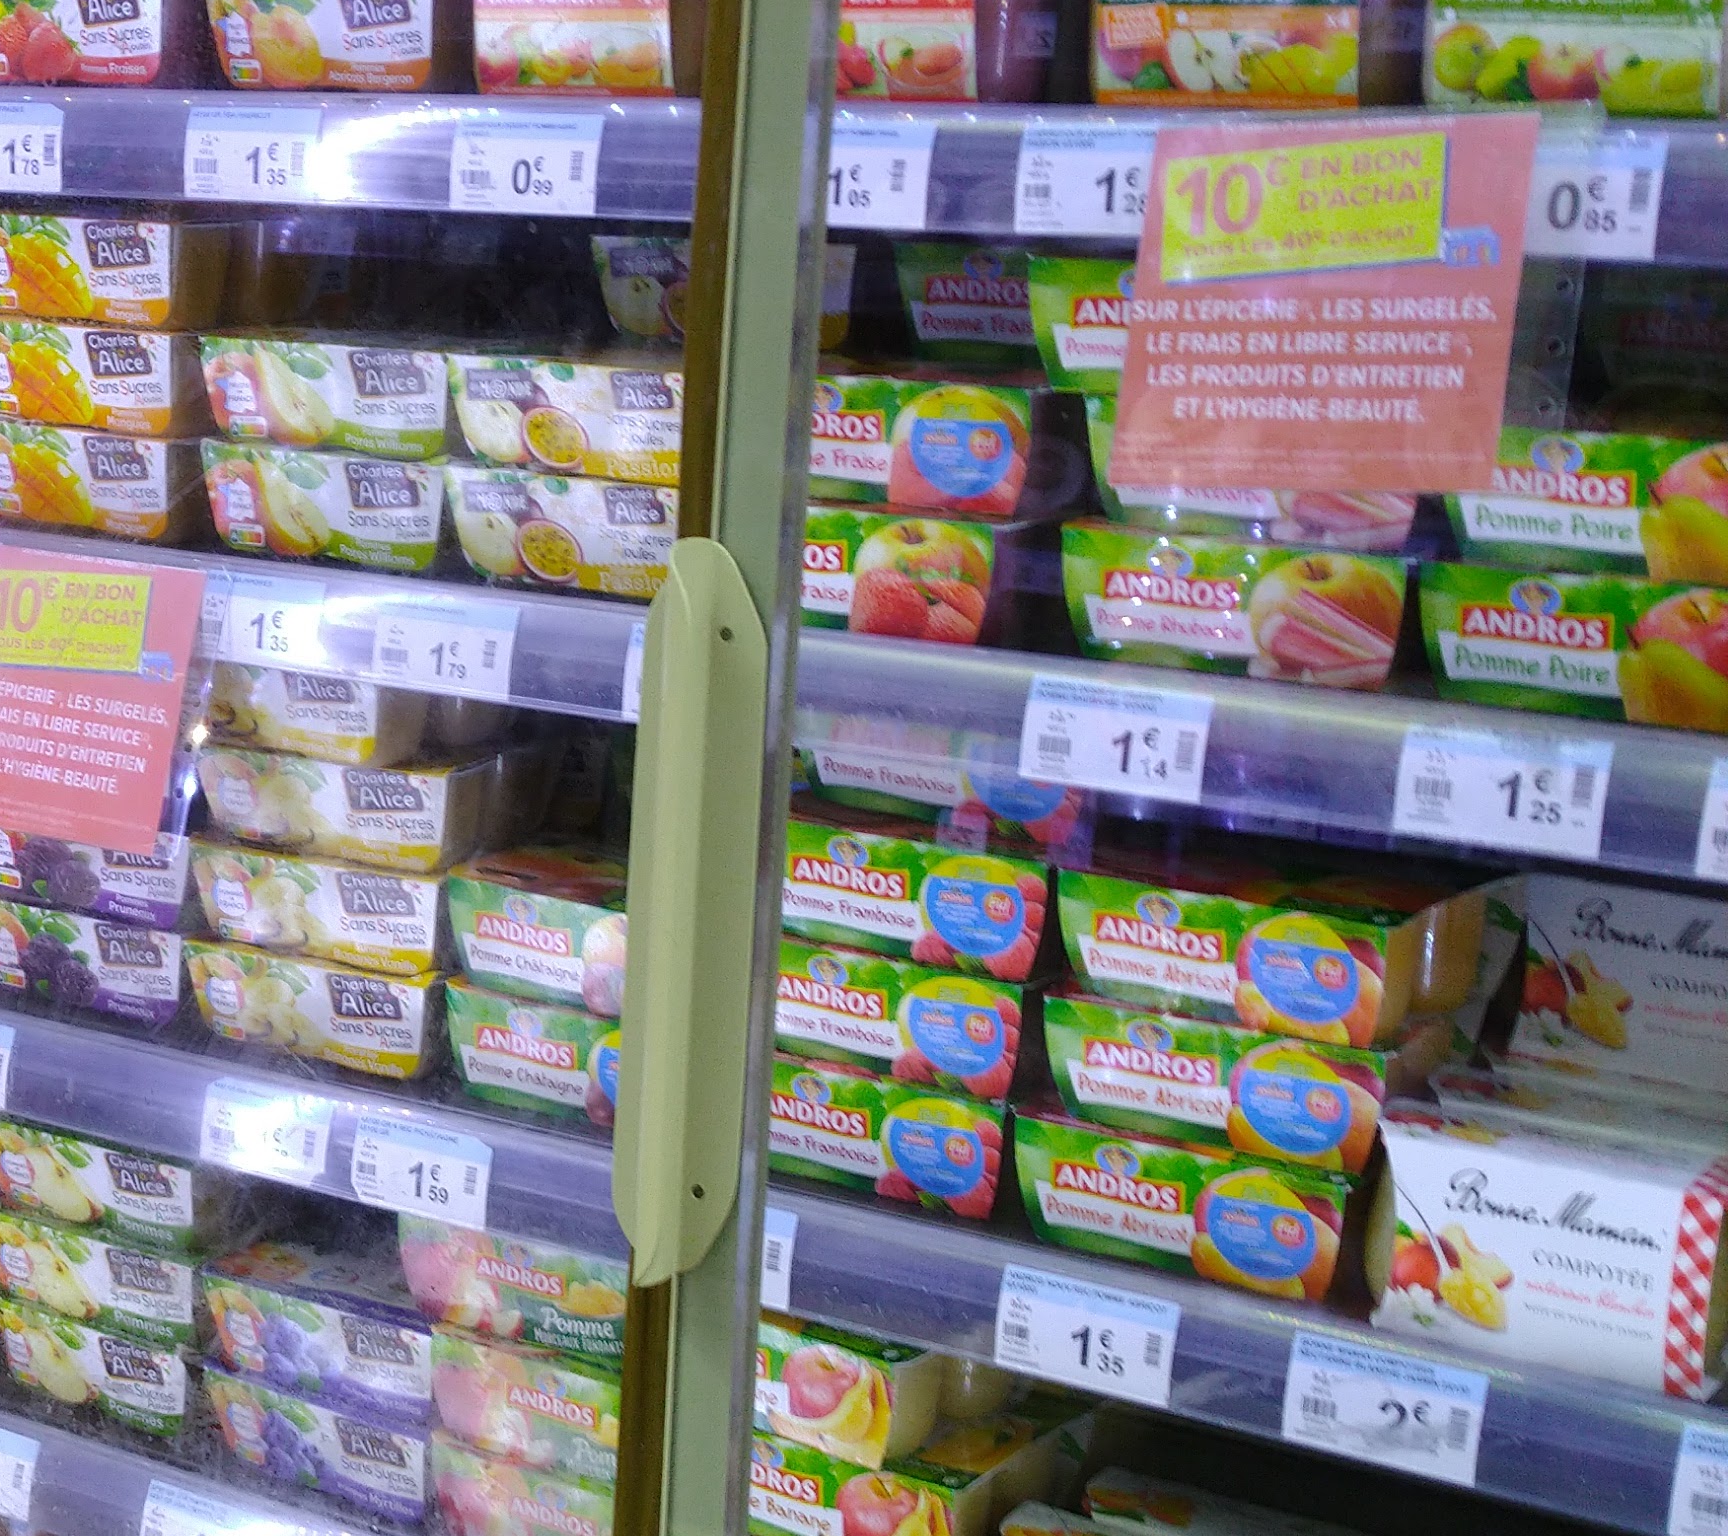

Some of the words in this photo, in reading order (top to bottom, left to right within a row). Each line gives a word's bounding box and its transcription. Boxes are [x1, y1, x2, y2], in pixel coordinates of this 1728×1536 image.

[87, 224, 135, 241] Charles
[98, 242, 144, 264] Alice
[1130, 300, 1178, 321] SUR
[1323, 298, 1363, 320] LES
[88, 334, 135, 349] Charles
[1146, 334, 1174, 354] LE
[1176, 333, 1242, 354] FRAIS
[1247, 333, 1277, 354] EN
[1282, 333, 1350, 355] LIBRE
[99, 351, 145, 373] Alice
[1147, 366, 1187, 386] LES
[1190, 366, 1305, 387] PRODUITS
[1175, 399, 1199, 419] ET
[98, 454, 141, 476] Alice
[1477, 502, 1564, 536] Pomme
[1572, 506, 1633, 542] Poire
[94, 583, 135, 602] BON
[1105, 572, 1237, 607] ANDROS
[1465, 605, 1604, 647] ANDROS
[1455, 647, 1544, 679] Pomme
[1550, 656, 1611, 684] Poire
[68, 691, 92, 709] LES
[23, 711, 41, 726] EN
[43, 712, 80, 735] LIBRE
[824, 757, 872, 781] Pomme
[878, 768, 955, 795] Framboise
[359, 785, 415, 807] Alice
[794, 858, 905, 898] ANDROS
[838, 900, 916, 928] Framboise
[478, 917, 568, 954] ANDROS
[1097, 917, 1221, 959] ANDROS
[1089, 947, 1158, 978] Pomme
[1163, 965, 1233, 993] Abricot
[342, 992, 396, 1017] Alice
[778, 978, 883, 1017] ANDROS
[479, 1028, 573, 1065] ANDROS
[821, 1019, 894, 1047] Framboise
[1088, 1040, 1214, 1083] ANDROS
[1078, 1072, 1146, 1101] Pomme
[1156, 1091, 1227, 1117] Abricot
[805, 1136, 878, 1164] Framboise
[1055, 1164, 1178, 1211] ANDROS
[1046, 1194, 1113, 1225] Pomme
[1121, 1213, 1189, 1244] Abricot
[478, 1259, 562, 1296] ANDROS
[544, 1306, 612, 1336] Pomme
[509, 1388, 595, 1428] ANDROS
[767, 1500, 830, 1530] Banane
